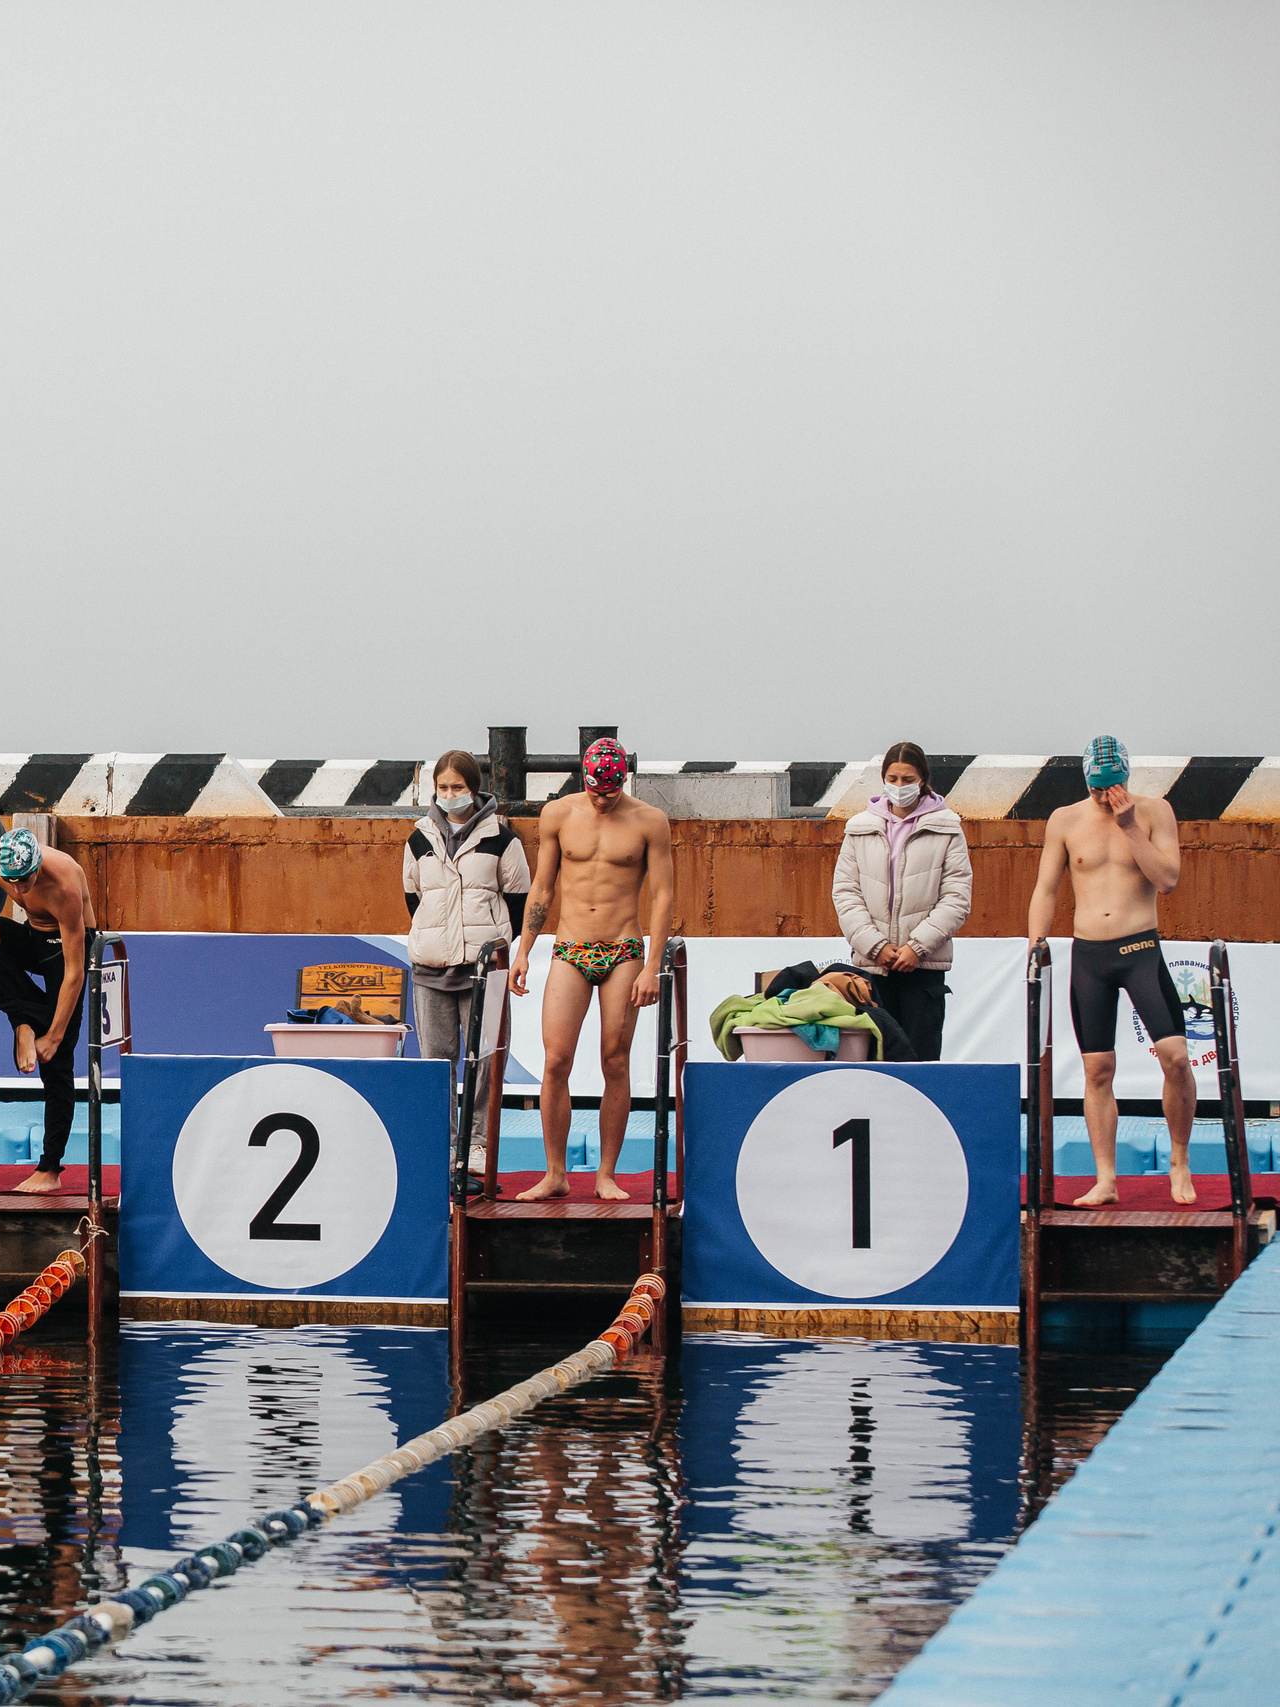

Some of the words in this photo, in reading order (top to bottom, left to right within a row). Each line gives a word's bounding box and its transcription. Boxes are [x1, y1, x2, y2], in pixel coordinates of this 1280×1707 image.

[315, 970, 387, 993] Kozel
[1119, 940, 1156, 955] arena
[247, 1112, 322, 1241] 2
[832, 1118, 871, 1249] 1
